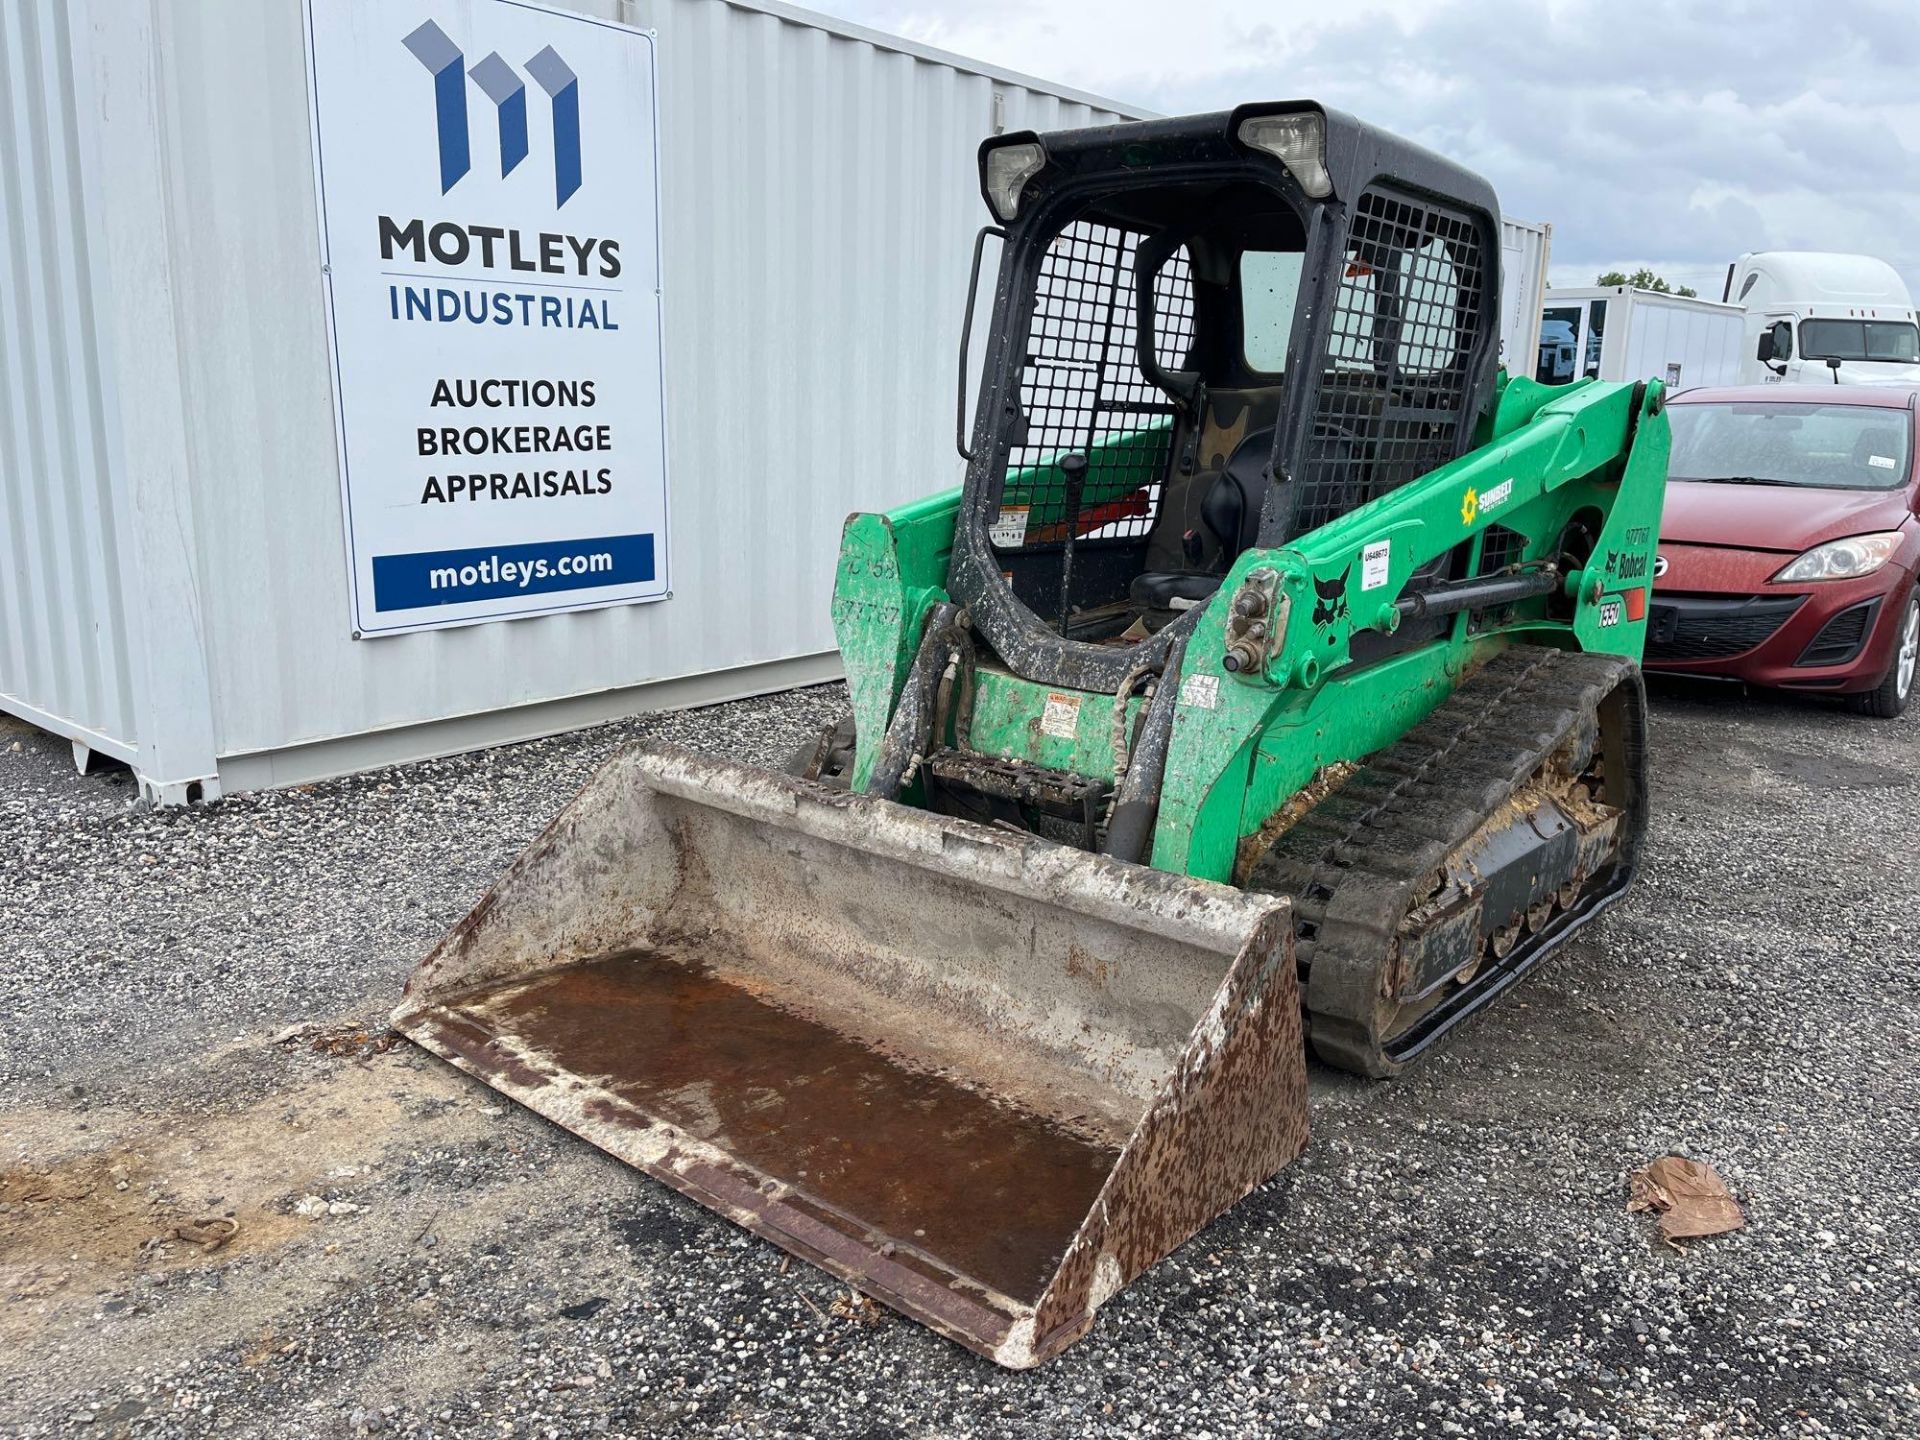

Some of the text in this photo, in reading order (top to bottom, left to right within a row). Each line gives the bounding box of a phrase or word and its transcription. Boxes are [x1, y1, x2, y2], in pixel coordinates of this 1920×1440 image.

[378, 215, 622, 278] MOTLEYS
[389, 285, 619, 330] INDUSTRIAL
[430, 379, 596, 407] AUCTIONS
[417, 425, 611, 456] BROKERAGE
[421, 468, 612, 504] APPRAISALS
[1478, 477, 1513, 511] SUNBELT
[430, 553, 612, 590] motleys.com
[1618, 552, 1648, 580] Bobcat
[1598, 601, 1621, 629] T550
